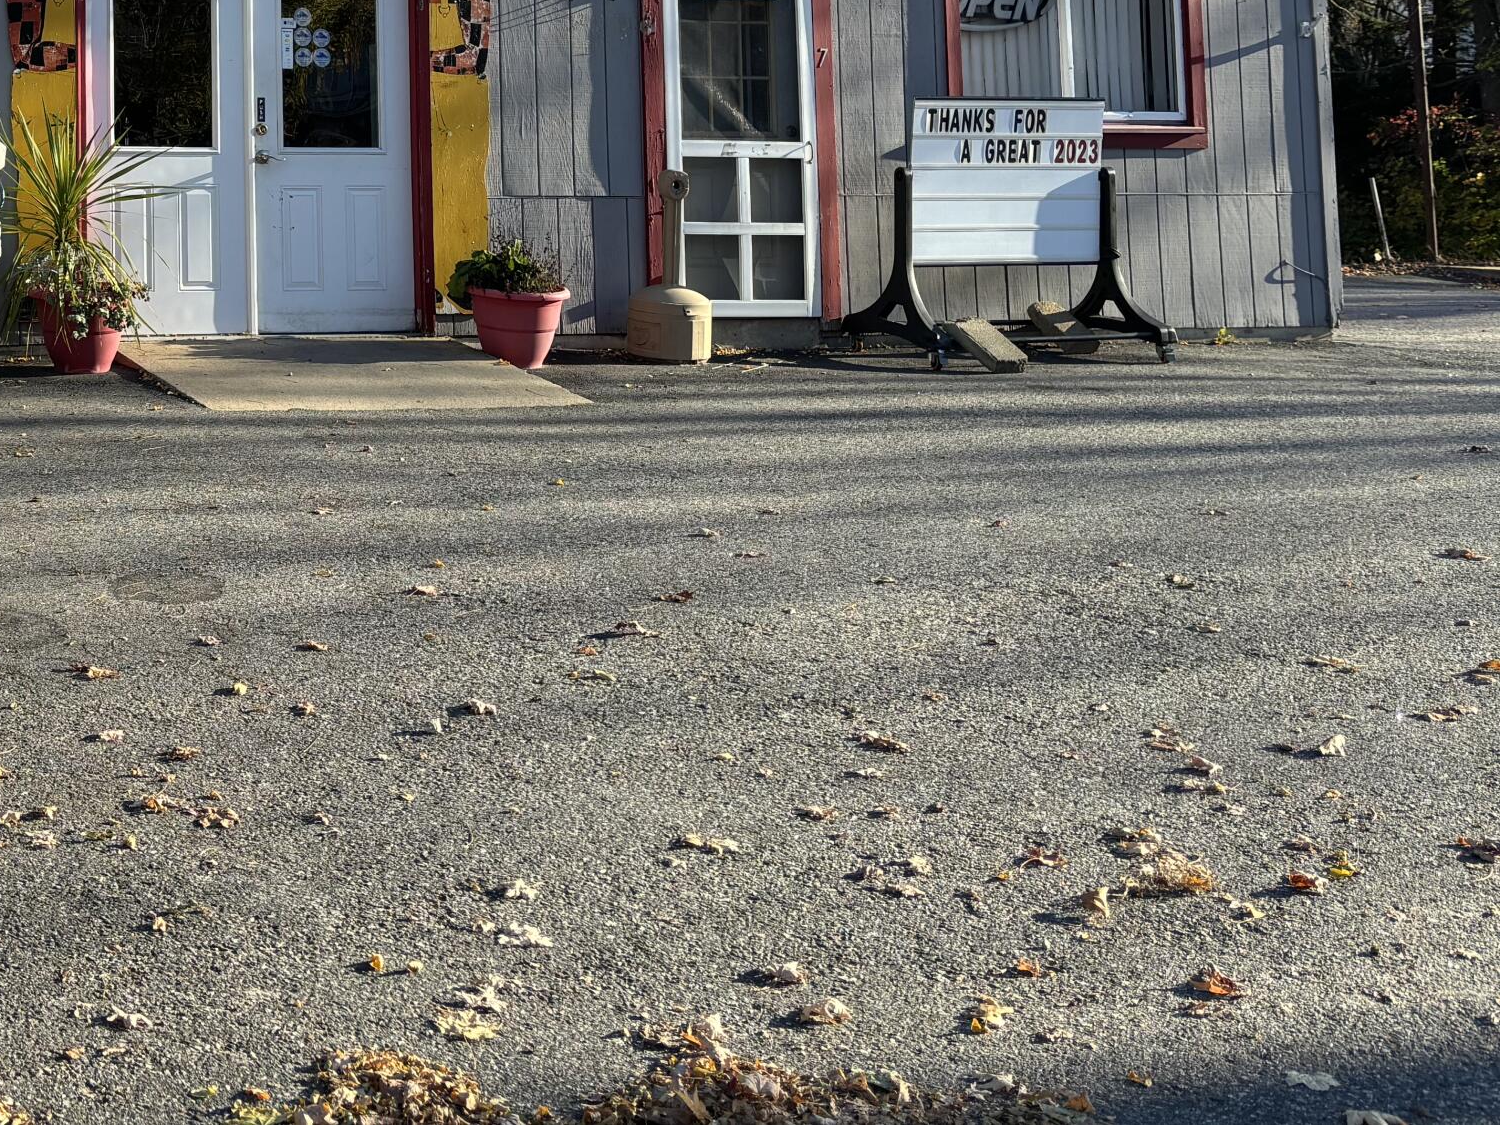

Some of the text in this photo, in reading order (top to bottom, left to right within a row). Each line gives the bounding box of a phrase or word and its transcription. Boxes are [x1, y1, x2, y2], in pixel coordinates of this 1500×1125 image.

[819, 47, 828, 68] 7
[928, 108, 1046, 133] THANKS FOR
[960, 139, 1099, 164] A GREAT 2023
